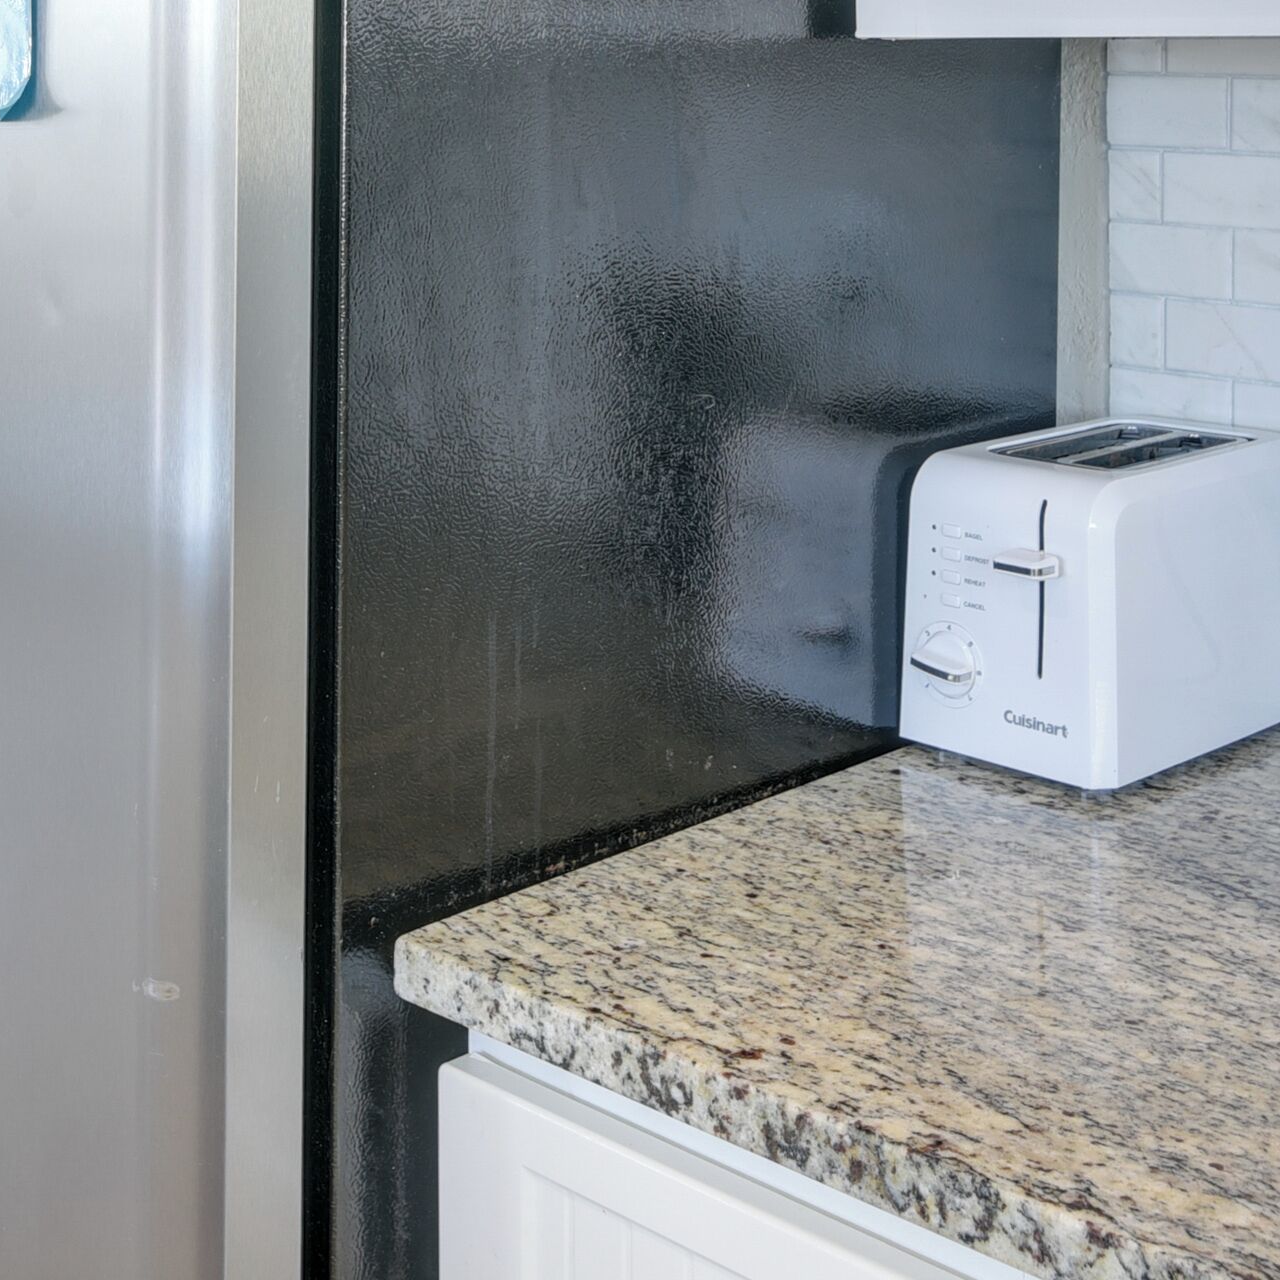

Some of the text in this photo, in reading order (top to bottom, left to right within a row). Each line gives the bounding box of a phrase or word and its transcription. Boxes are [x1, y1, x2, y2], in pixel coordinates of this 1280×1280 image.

[964, 532, 982, 541] BAGEL
[964, 554, 989, 565] DEFROST
[964, 578, 986, 587] REHEAT
[963, 601, 986, 611] CANCEL
[1003, 709, 1068, 738] Cuisinart
